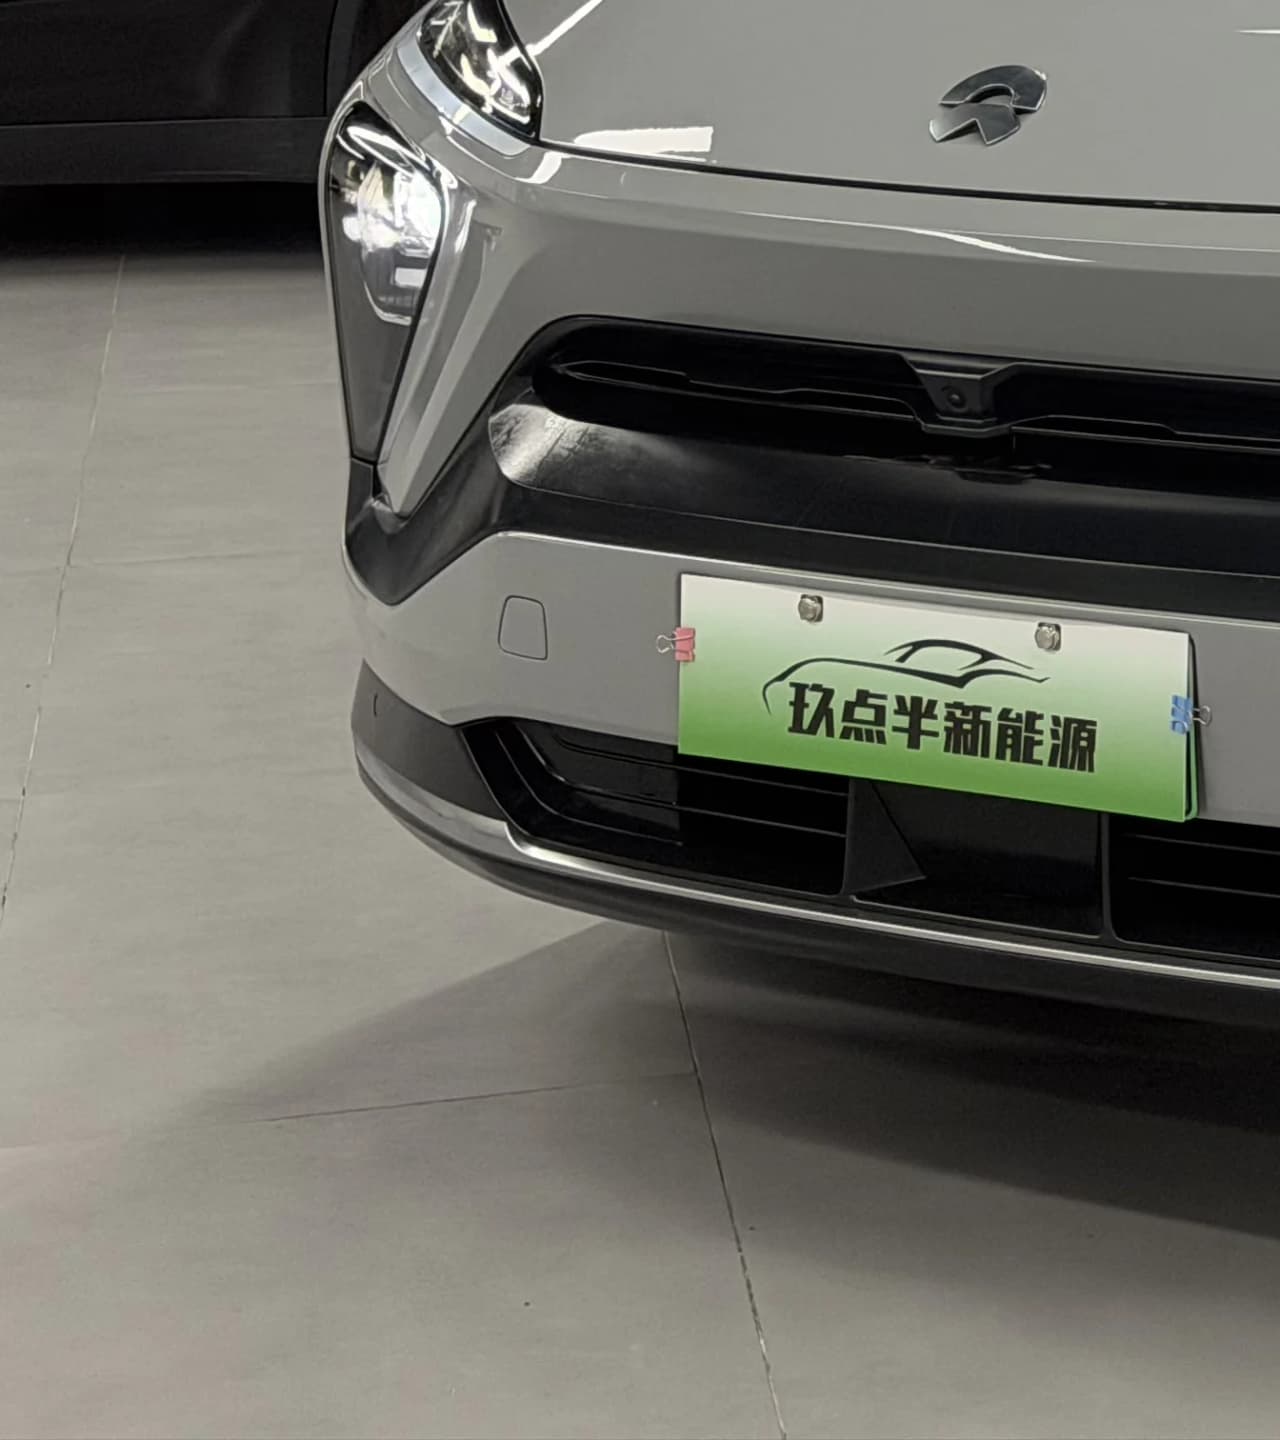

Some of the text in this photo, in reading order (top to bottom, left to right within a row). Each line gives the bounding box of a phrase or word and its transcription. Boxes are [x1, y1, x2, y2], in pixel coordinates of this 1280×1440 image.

[787, 681, 1098, 773] 玖点半新能源
